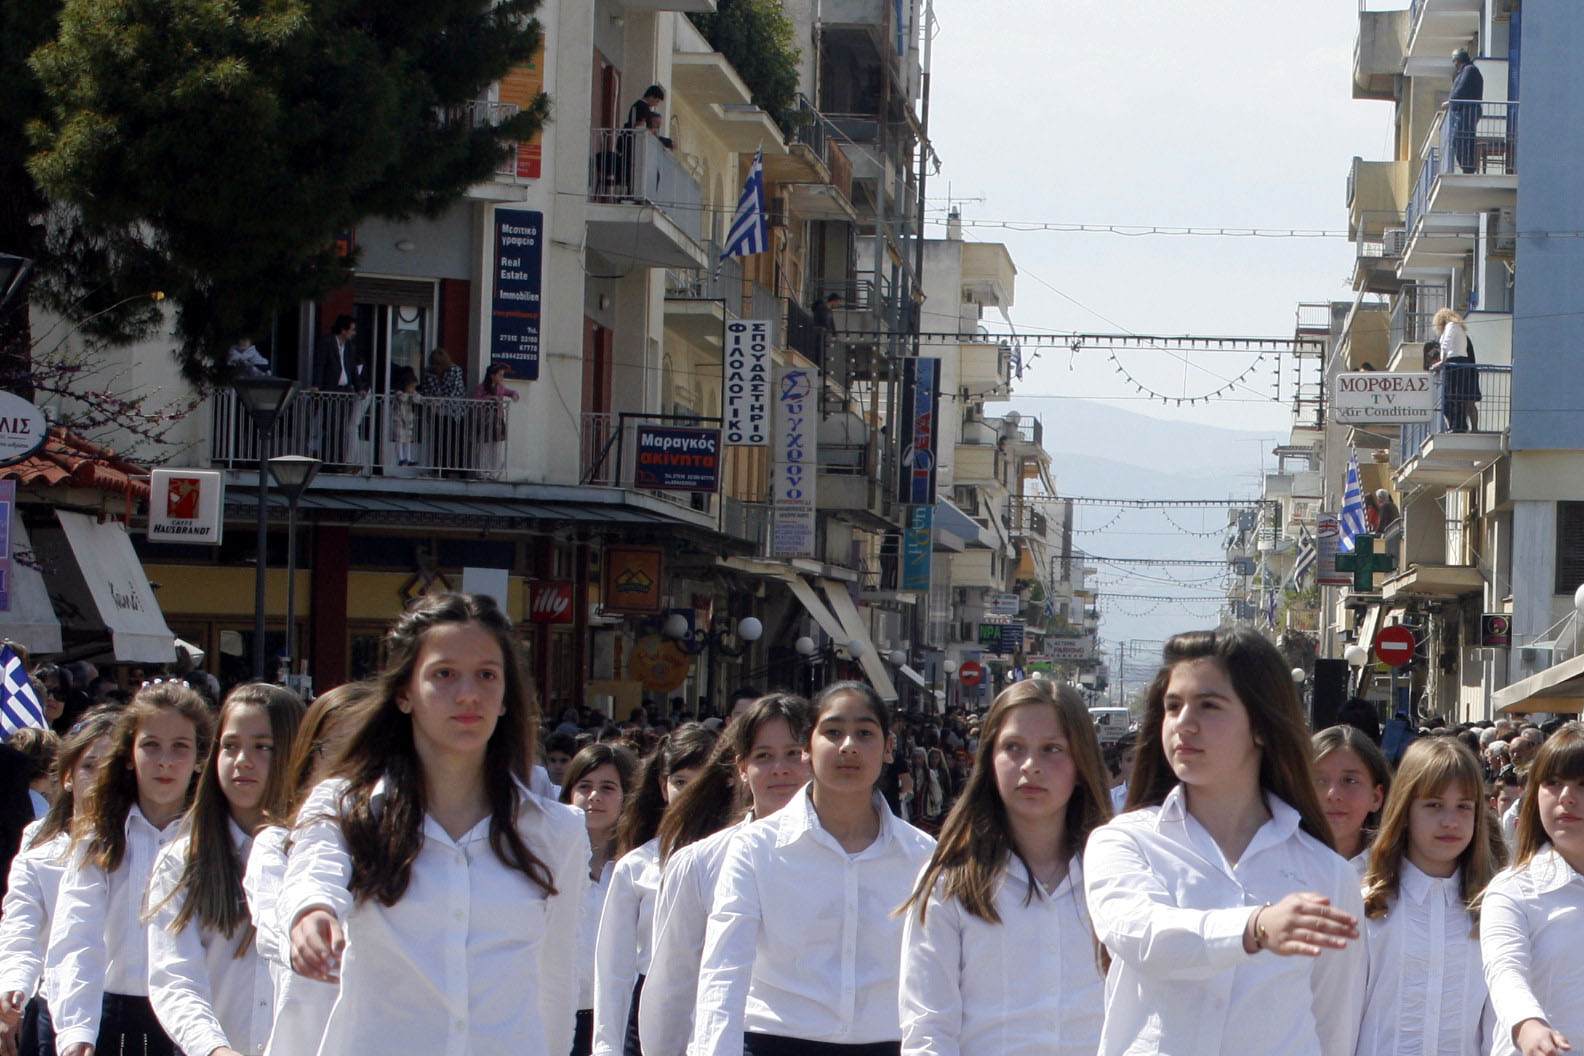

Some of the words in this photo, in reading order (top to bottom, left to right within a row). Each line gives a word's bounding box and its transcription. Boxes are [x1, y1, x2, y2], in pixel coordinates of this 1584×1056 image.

[501, 223, 537, 236] Μεσιτικό
[501, 236, 535, 247] γραφείο
[501, 257, 521, 267] Real
[501, 270, 528, 280] Estate
[500, 289, 539, 302] Immobilien
[728, 323, 747, 442] ΦΙΛΟΛΟΓΙΚΟ
[749, 323, 766, 442] ΣΠΟΥΔΑΣΤΗΡΙΟ
[1339, 377, 1429, 392] ΜΟΡΦΕΑΣ
[1341, 407, 1362, 417] Air
[1365, 406, 1427, 418] Condition
[641, 433, 715, 453] Μαραγκός
[153, 524, 211, 535] HAUSBRANDT
[532, 587, 569, 618] illy
